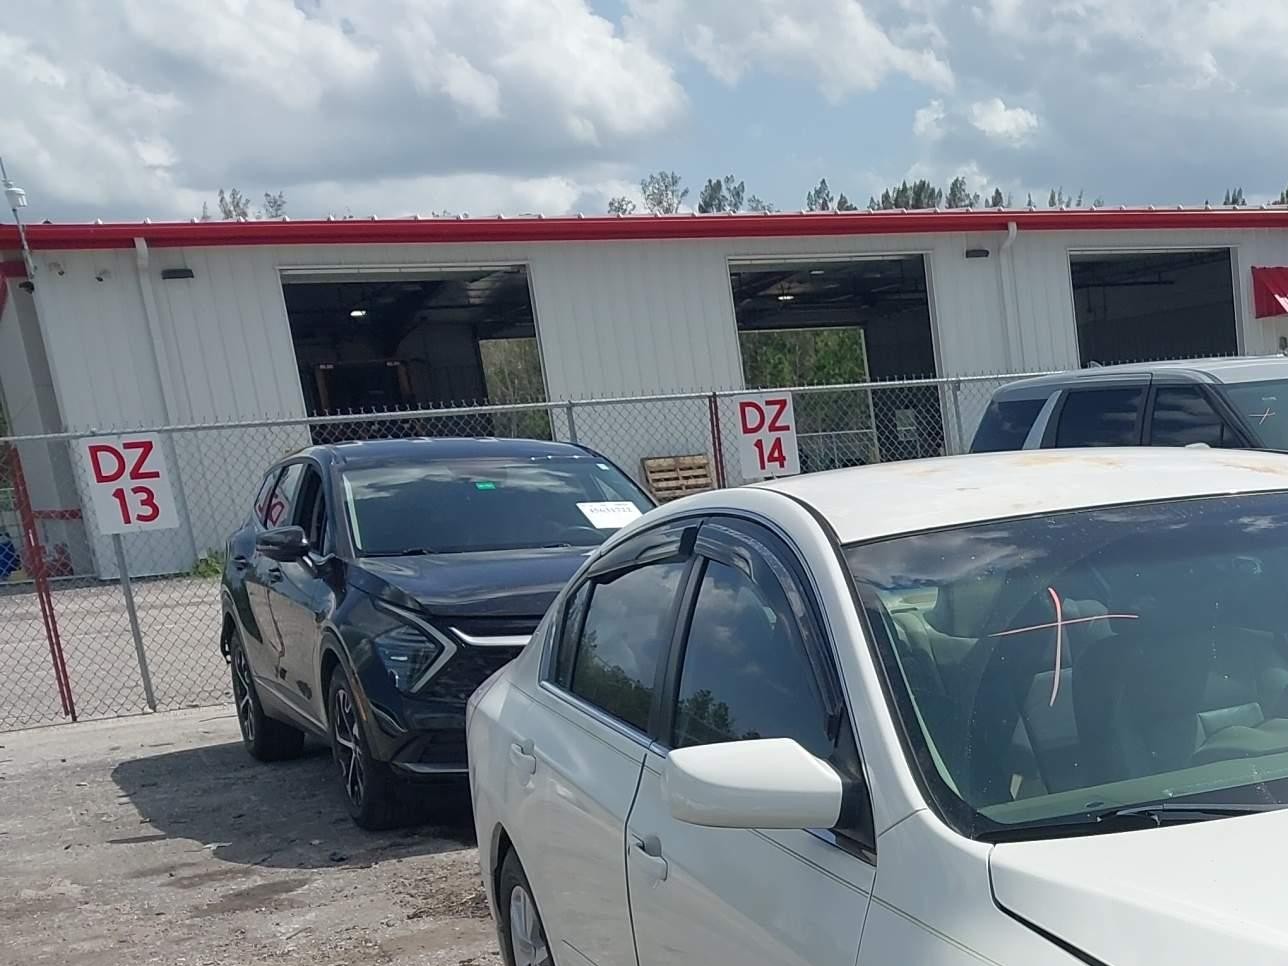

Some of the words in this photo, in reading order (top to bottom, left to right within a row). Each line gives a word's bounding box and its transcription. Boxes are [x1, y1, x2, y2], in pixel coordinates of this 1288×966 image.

[738, 398, 791, 435] DZ
[87, 440, 161, 484] DZ
[753, 436, 787, 471] 14
[111, 485, 161, 525] 13
